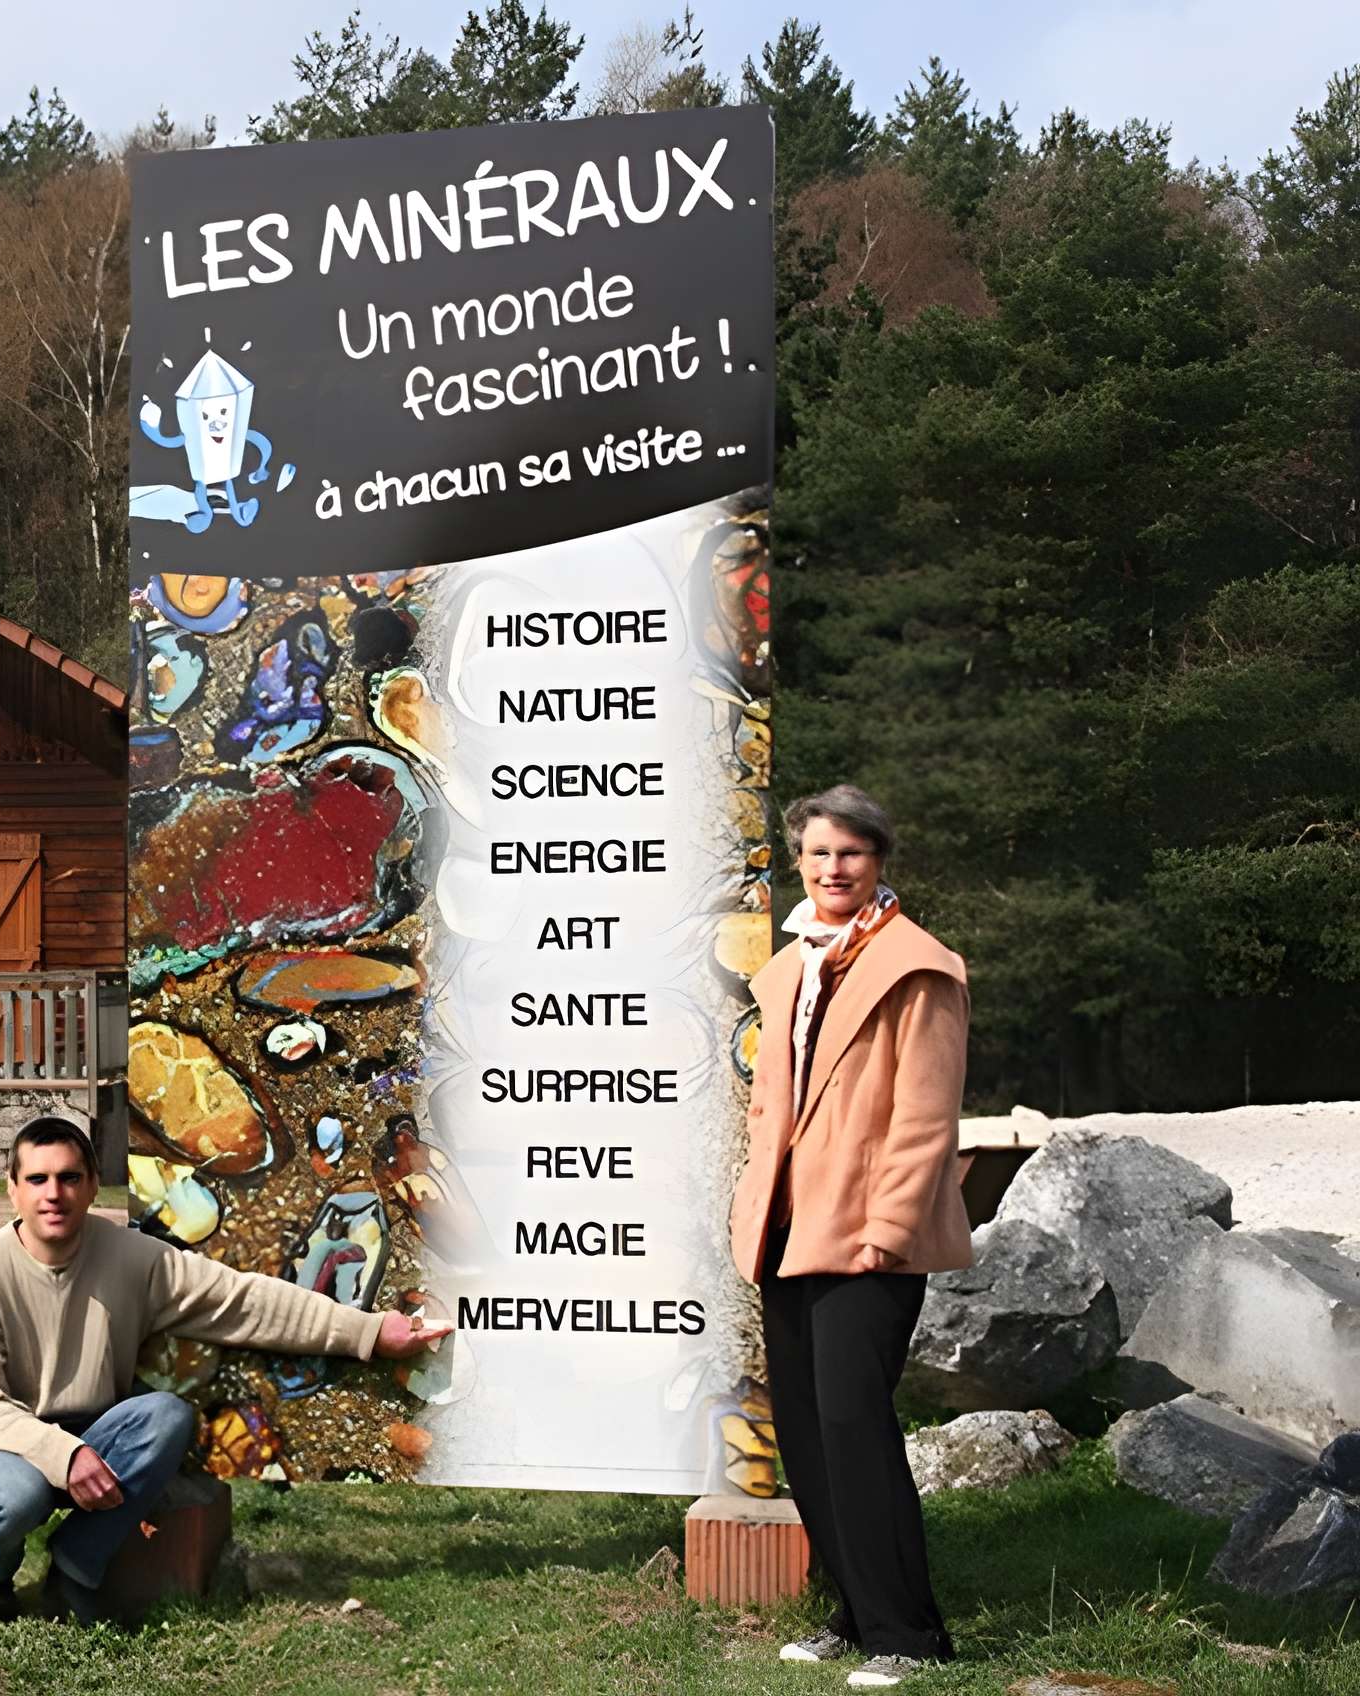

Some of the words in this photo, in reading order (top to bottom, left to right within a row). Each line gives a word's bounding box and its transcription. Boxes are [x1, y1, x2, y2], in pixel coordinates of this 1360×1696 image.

[162, 213, 294, 299] LES
[319, 138, 734, 275] MINÉRAUX
[338, 303, 416, 360] Un
[431, 266, 634, 346] monde
[402, 325, 700, 421] fascinant
[315, 479, 343, 520] à
[354, 458, 507, 513] chacun
[518, 450, 571, 487] sa
[582, 424, 703, 477] visite
[487, 609, 668, 648] HISTOIRE
[498, 686, 656, 724] NATURE
[491, 762, 665, 800] SCIENCE
[490, 839, 667, 875] ENERGIE
[536, 916, 620, 950] ART
[511, 992, 648, 1028] SANTE
[481, 1068, 678, 1104] SURPRISE
[527, 1146, 634, 1179] REVE
[515, 1221, 646, 1257] MAGIE
[457, 1296, 706, 1336] MERVEILLES
